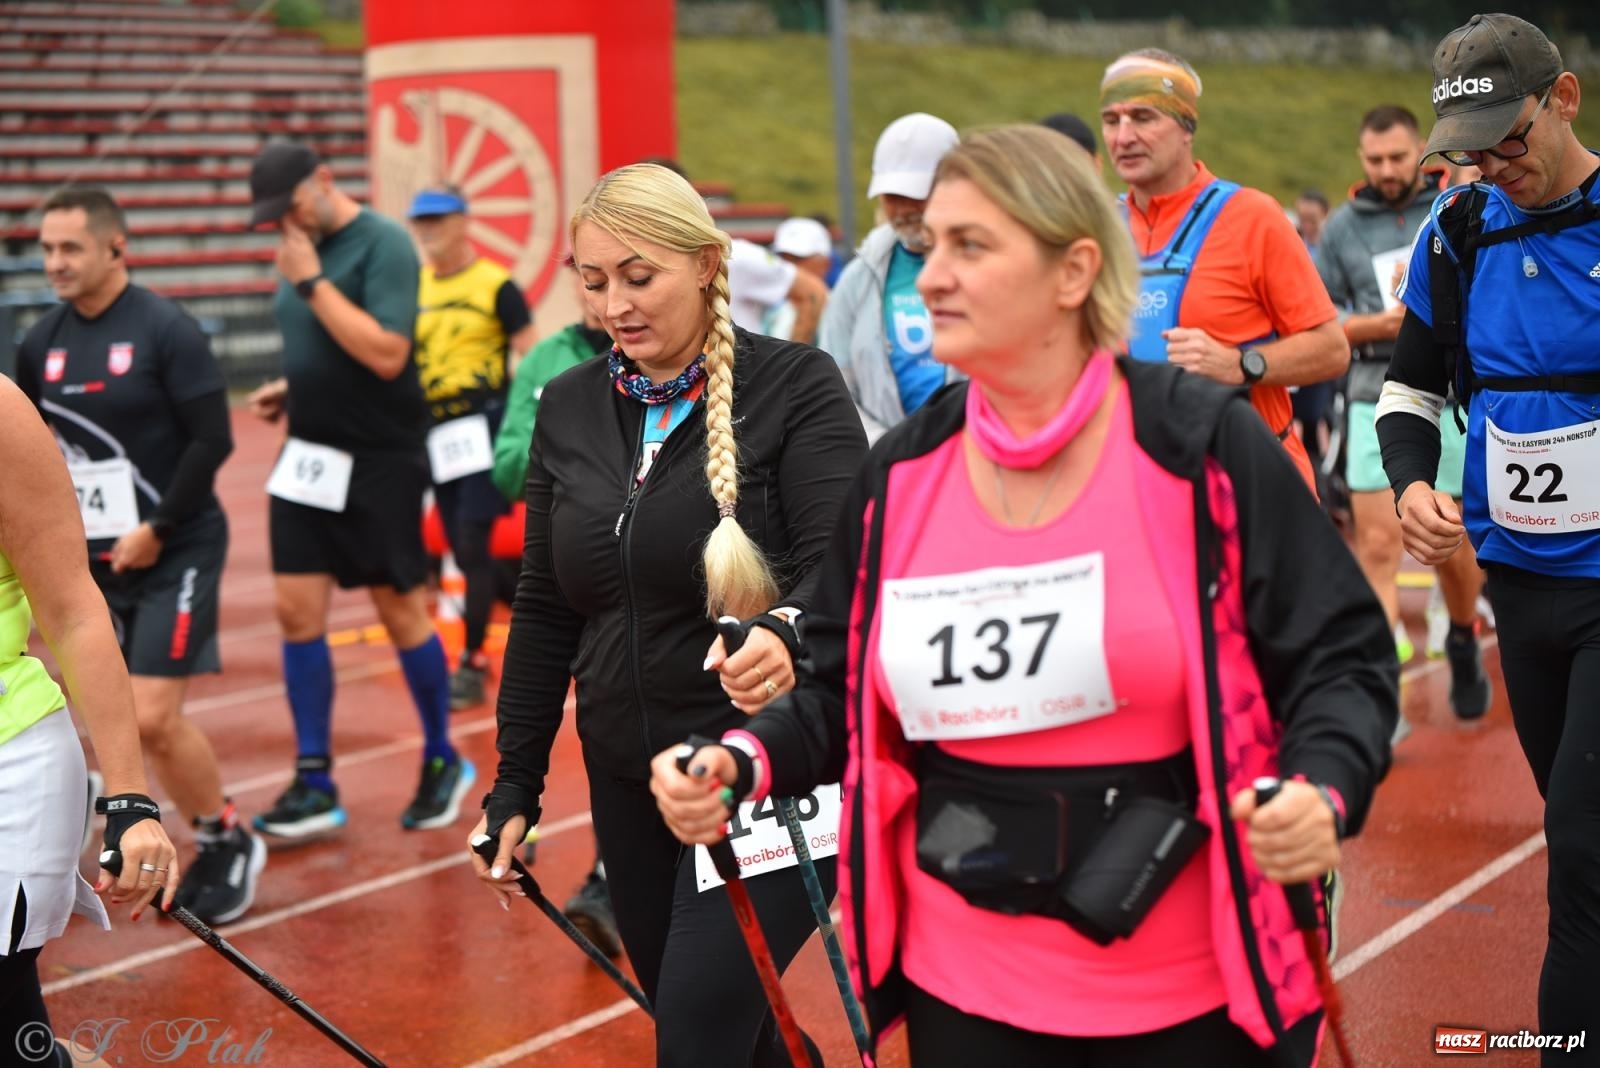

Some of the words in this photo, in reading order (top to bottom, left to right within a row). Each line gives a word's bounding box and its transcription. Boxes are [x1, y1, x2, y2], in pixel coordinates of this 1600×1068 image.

[1433, 75, 1494, 103] adidas
[1522, 438, 1551, 448] EASYRUN
[1553, 436, 1565, 445] 24h
[1506, 463, 1568, 503] 22
[1505, 511, 1556, 526] Racibórz
[1570, 511, 1600, 524] OSiR
[928, 613, 1060, 687] 137
[811, 832, 838, 849] OSiR
